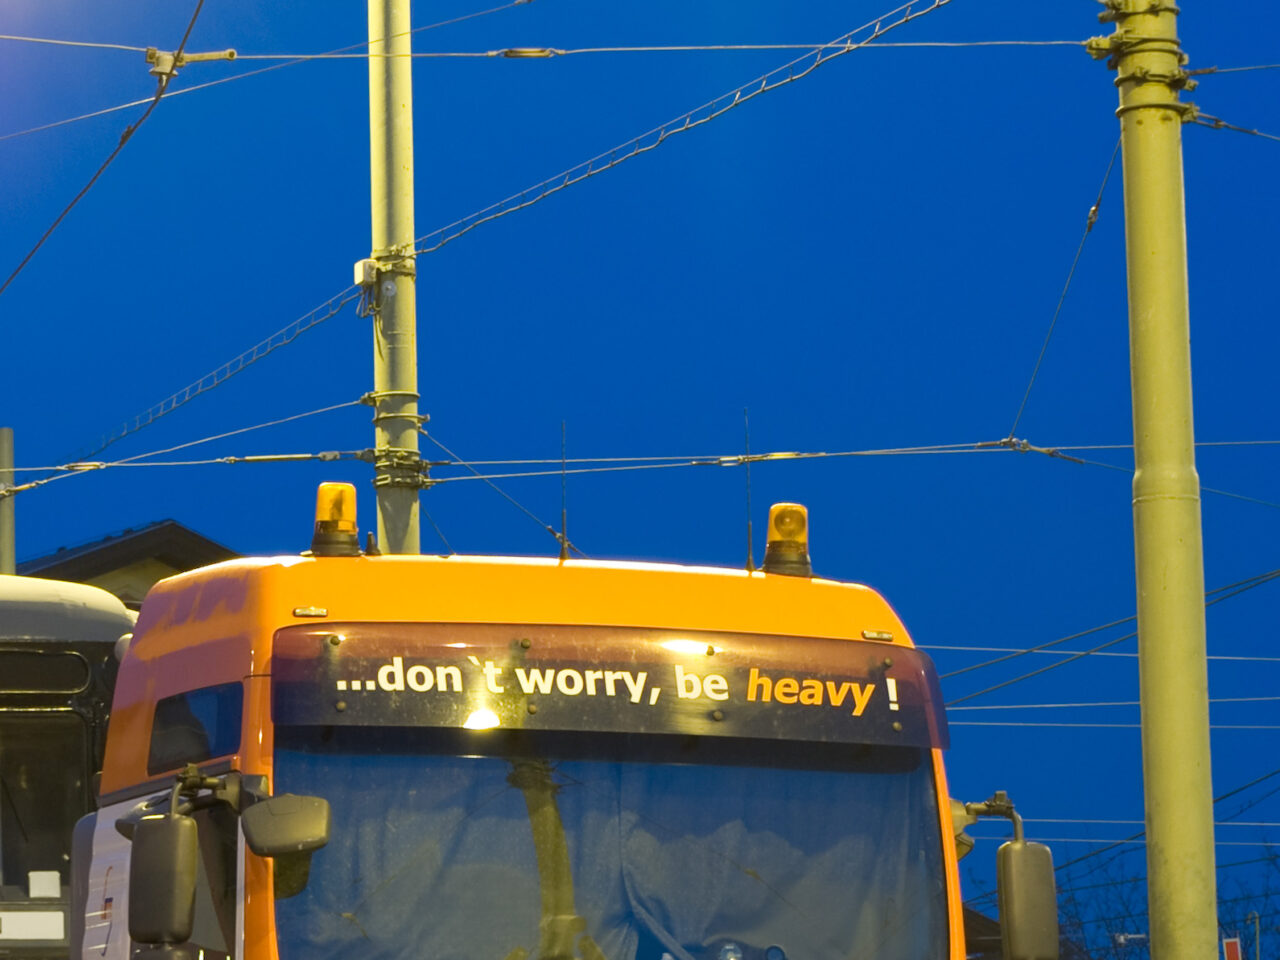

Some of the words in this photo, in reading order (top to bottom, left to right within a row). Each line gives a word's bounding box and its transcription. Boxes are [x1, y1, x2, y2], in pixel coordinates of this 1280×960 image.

[515, 668, 662, 706] worry,
[675, 665, 729, 701] be
[746, 668, 875, 717] heavy
